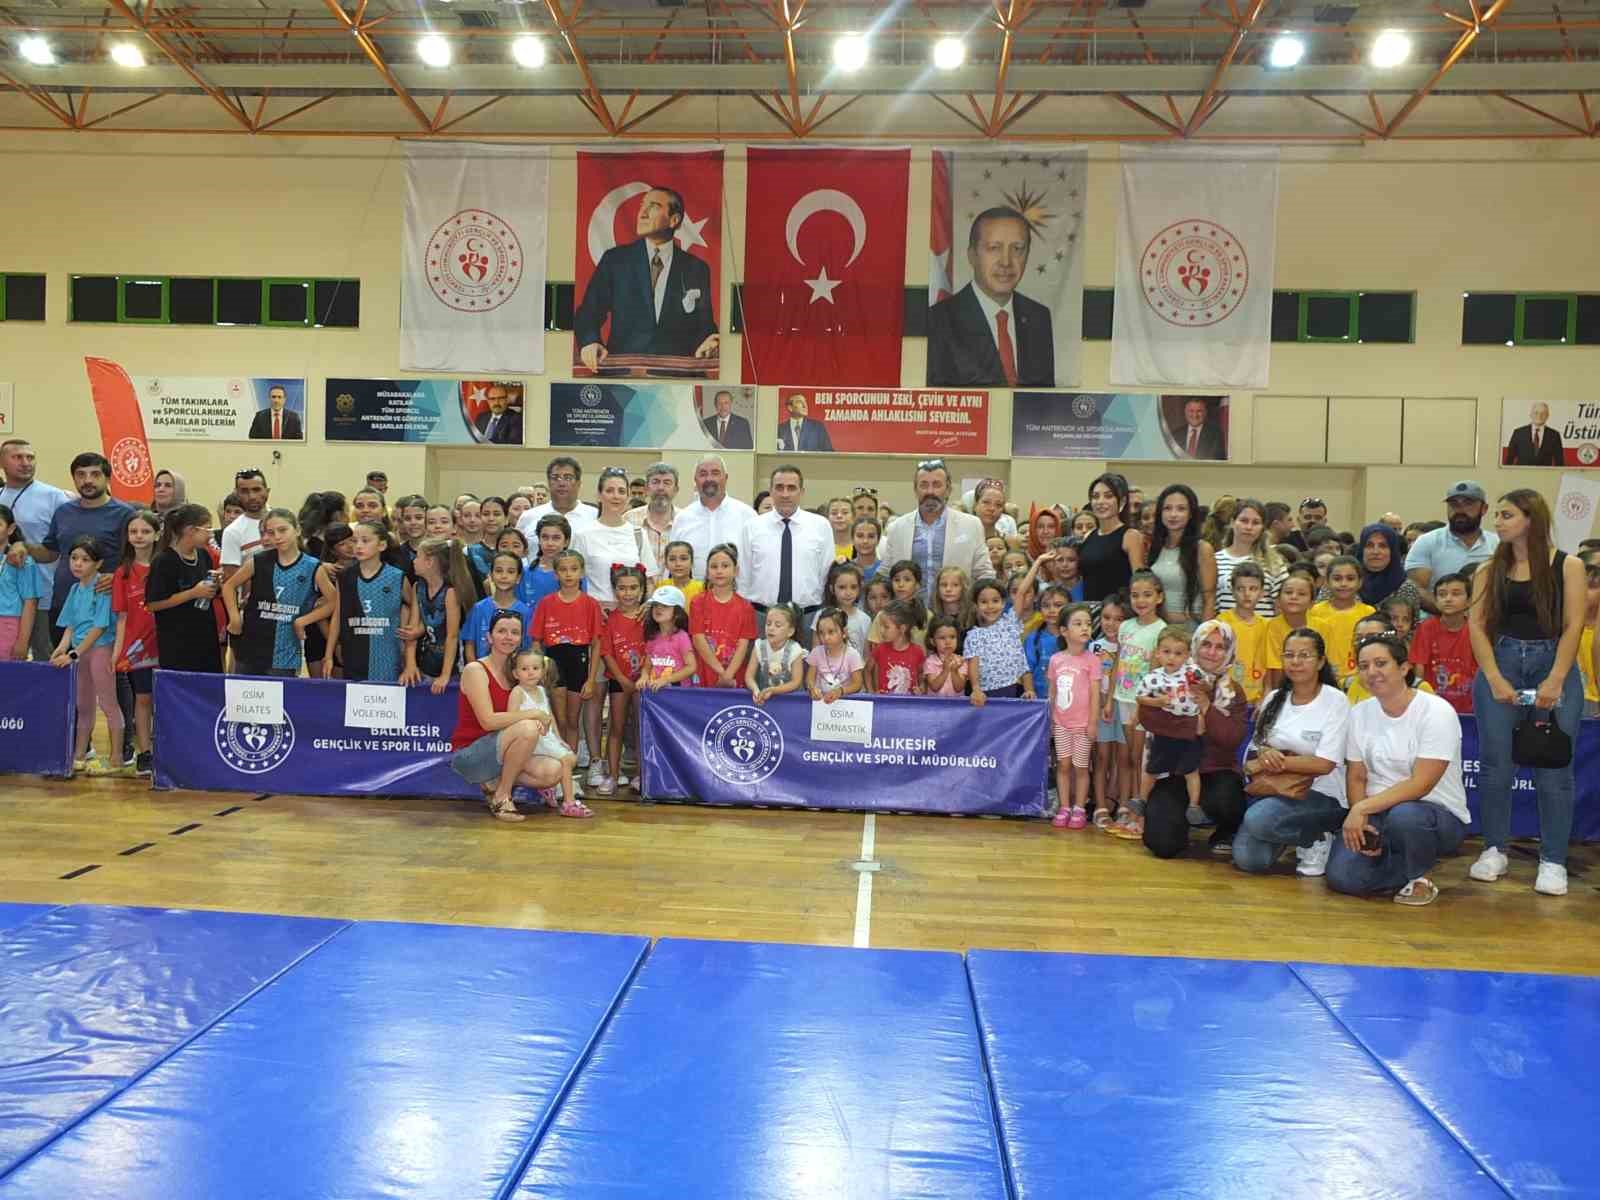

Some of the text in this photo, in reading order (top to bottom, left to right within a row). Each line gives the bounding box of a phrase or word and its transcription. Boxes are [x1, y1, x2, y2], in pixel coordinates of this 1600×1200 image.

[160, 397, 229, 406] TÜM TAKIMLARA
[815, 390, 982, 409] BEN SPORCUNUN ZEKİ, ÇEVİK VE AYNI
[163, 408, 237, 416] SPORCULARIMIZA
[824, 409, 869, 422] ZAMANDA
[929, 408, 972, 424] SEVERİM.
[153, 417, 236, 427] BAŞARILAR DİLERİM
[276, 586, 285, 599] 7
[352, 708, 398, 720] VOLEYBOL
[313, 739, 362, 751] GENÇLİK
[364, 740, 379, 750] VE
[382, 741, 410, 752] SPOR
[413, 739, 424, 752] İL
[802, 750, 997, 769] GENÇLİK VE SPOR İL MÜDÜRLÜĞÜ
